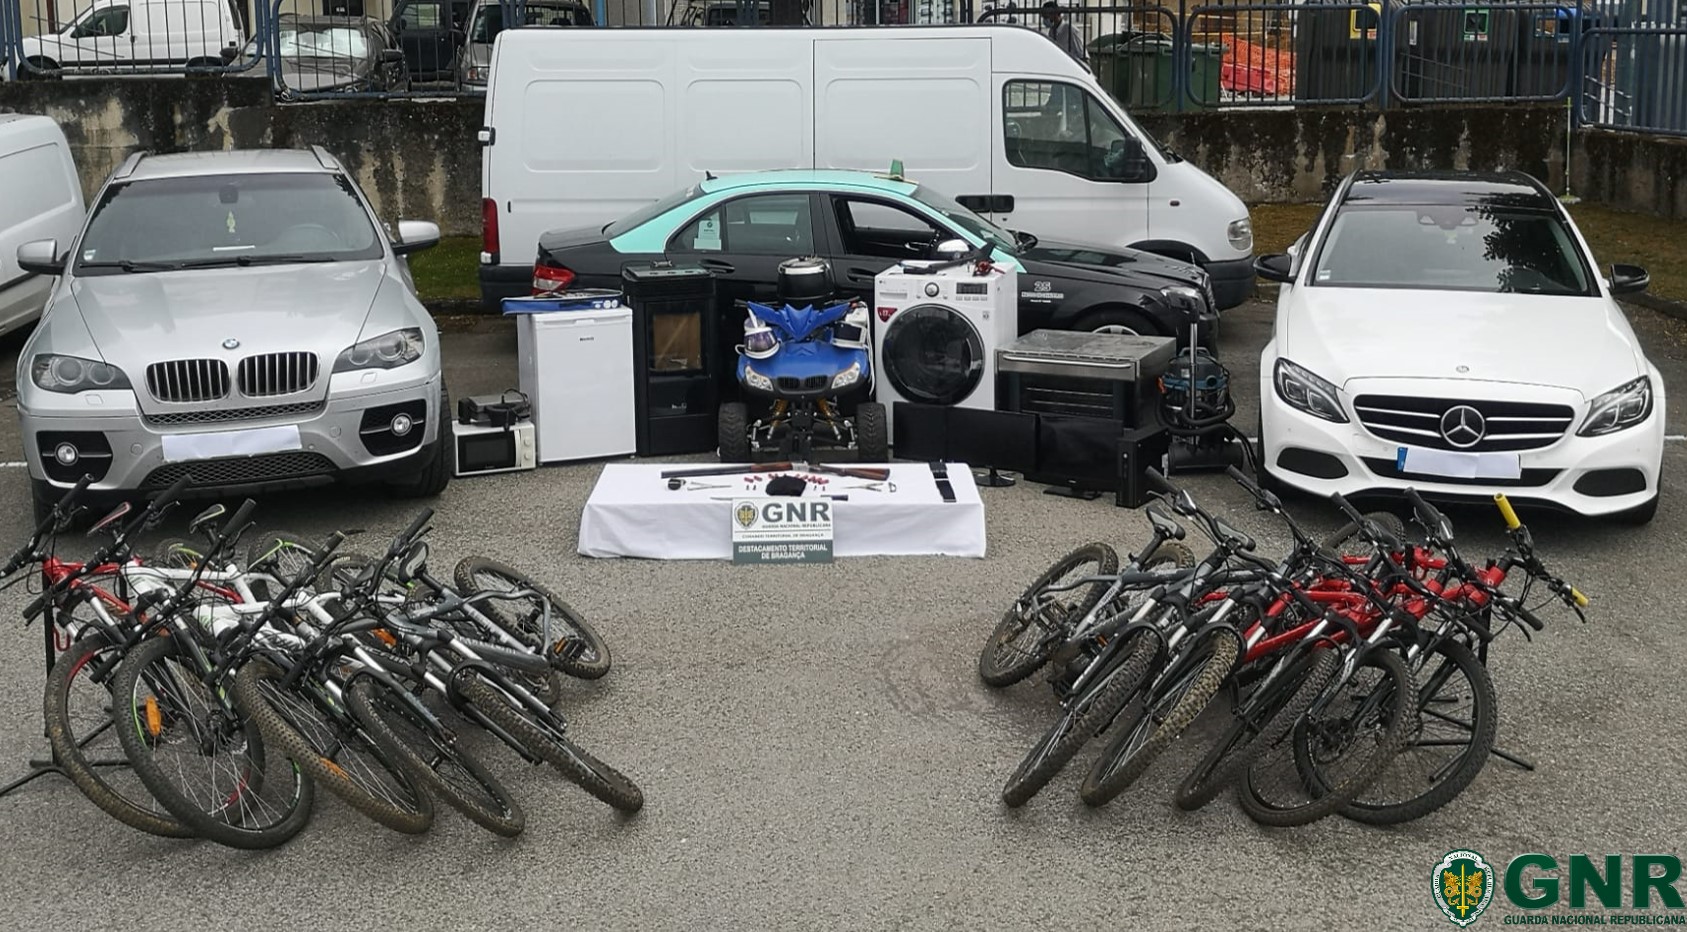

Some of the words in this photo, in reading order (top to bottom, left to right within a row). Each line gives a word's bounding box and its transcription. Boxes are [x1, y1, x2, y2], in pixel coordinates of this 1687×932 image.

[762, 502, 831, 522] GNR
[738, 544, 787, 553] DESTACAMENTO
[788, 543, 828, 552] TERRITORIAL
[771, 551, 805, 560] BRAGANÇA
